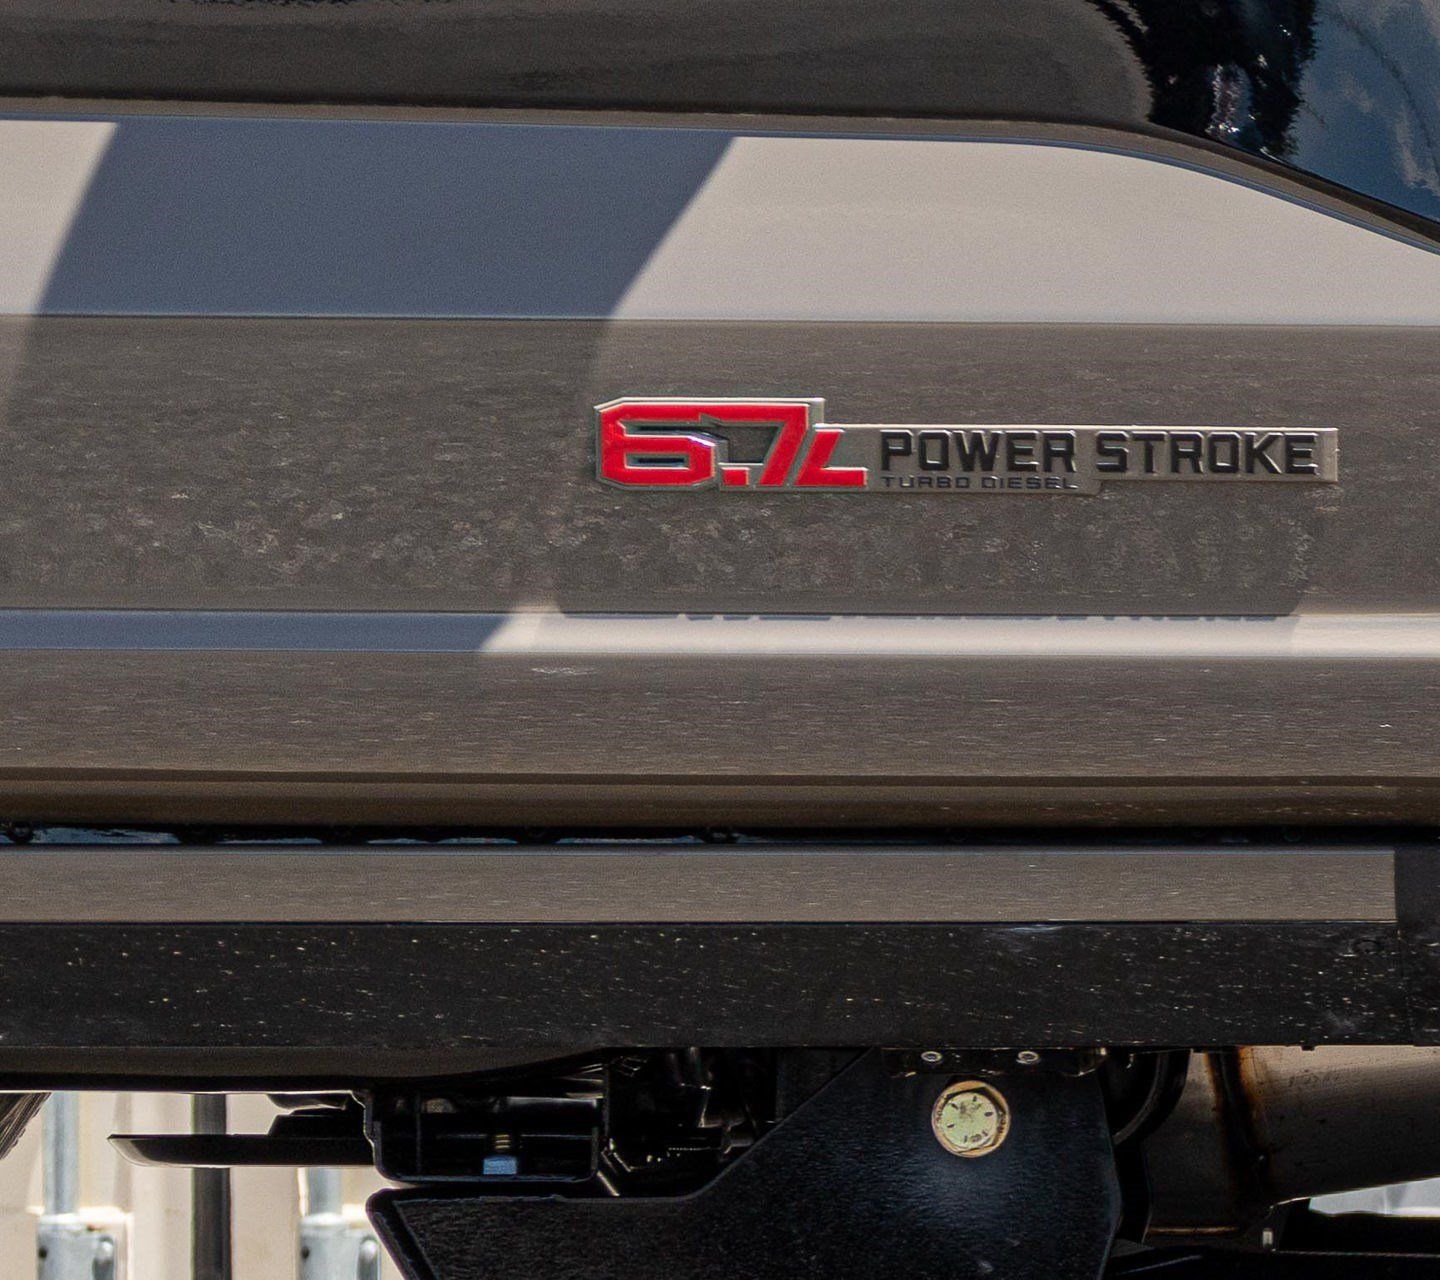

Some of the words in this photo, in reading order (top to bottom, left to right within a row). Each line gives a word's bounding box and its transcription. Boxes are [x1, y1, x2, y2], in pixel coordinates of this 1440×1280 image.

[597, 399, 868, 489] 6.7L
[879, 429, 1077, 473] POWER
[1095, 430, 1320, 475] STROKE
[881, 476, 970, 489] TURBO
[981, 476, 1079, 490] DIESEL
